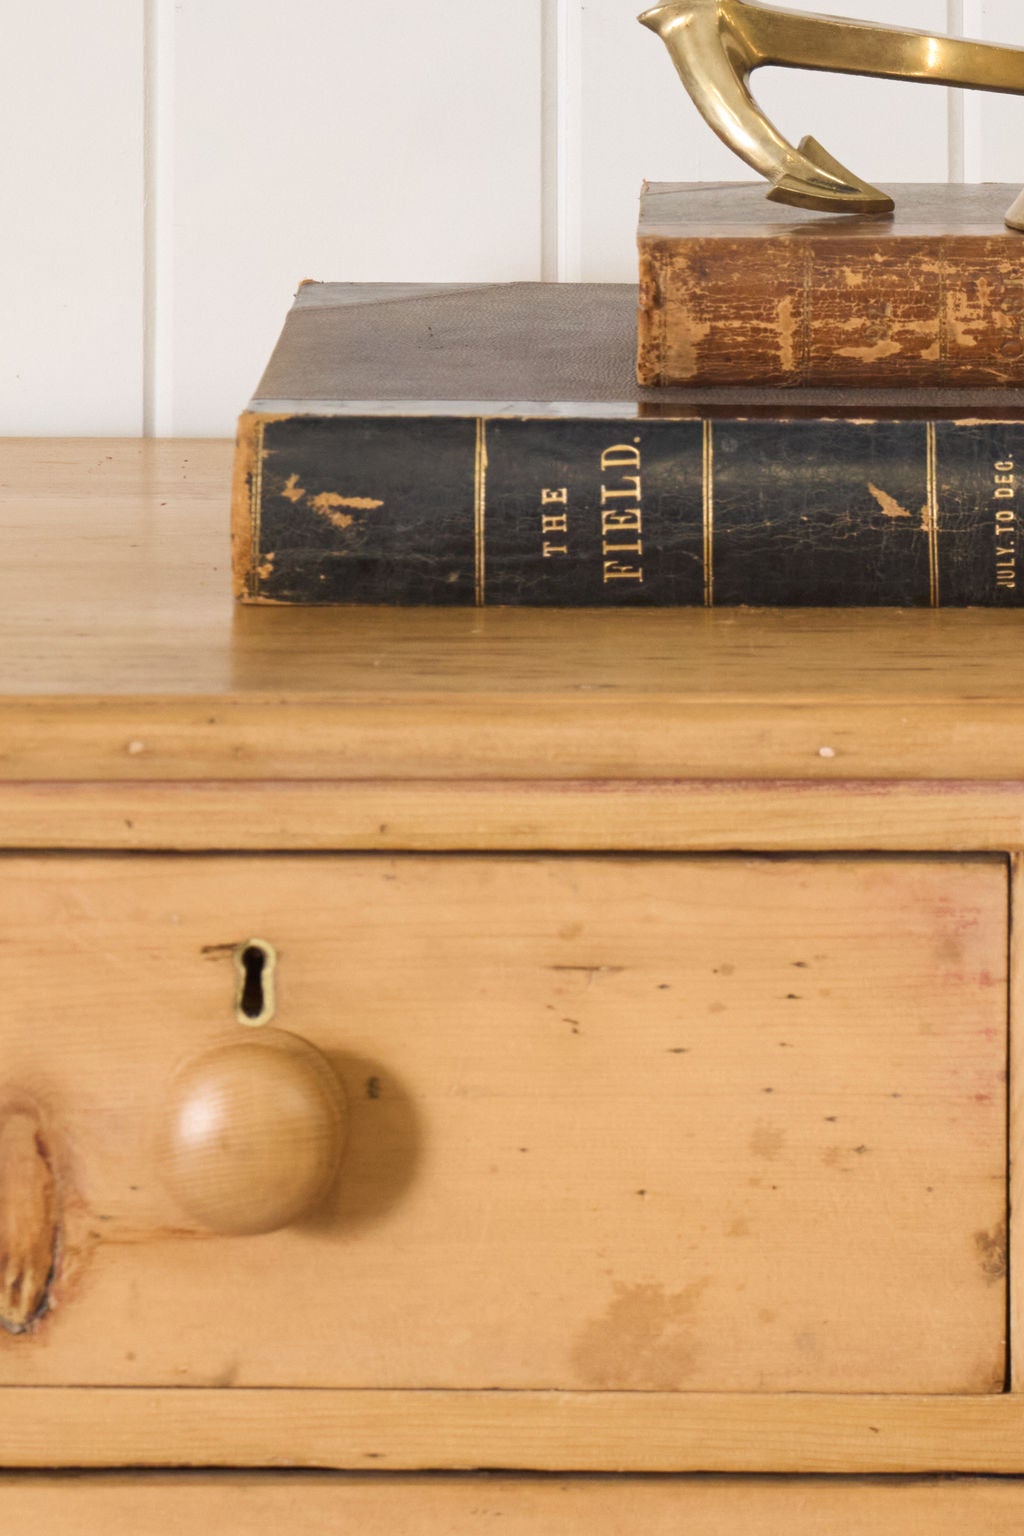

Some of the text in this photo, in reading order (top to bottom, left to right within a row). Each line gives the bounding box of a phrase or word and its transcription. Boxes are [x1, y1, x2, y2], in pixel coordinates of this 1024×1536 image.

[540, 487, 568, 558] THE
[600, 435, 643, 584] FIELD.
[993, 453, 1016, 589] JULY. TO DEC.
